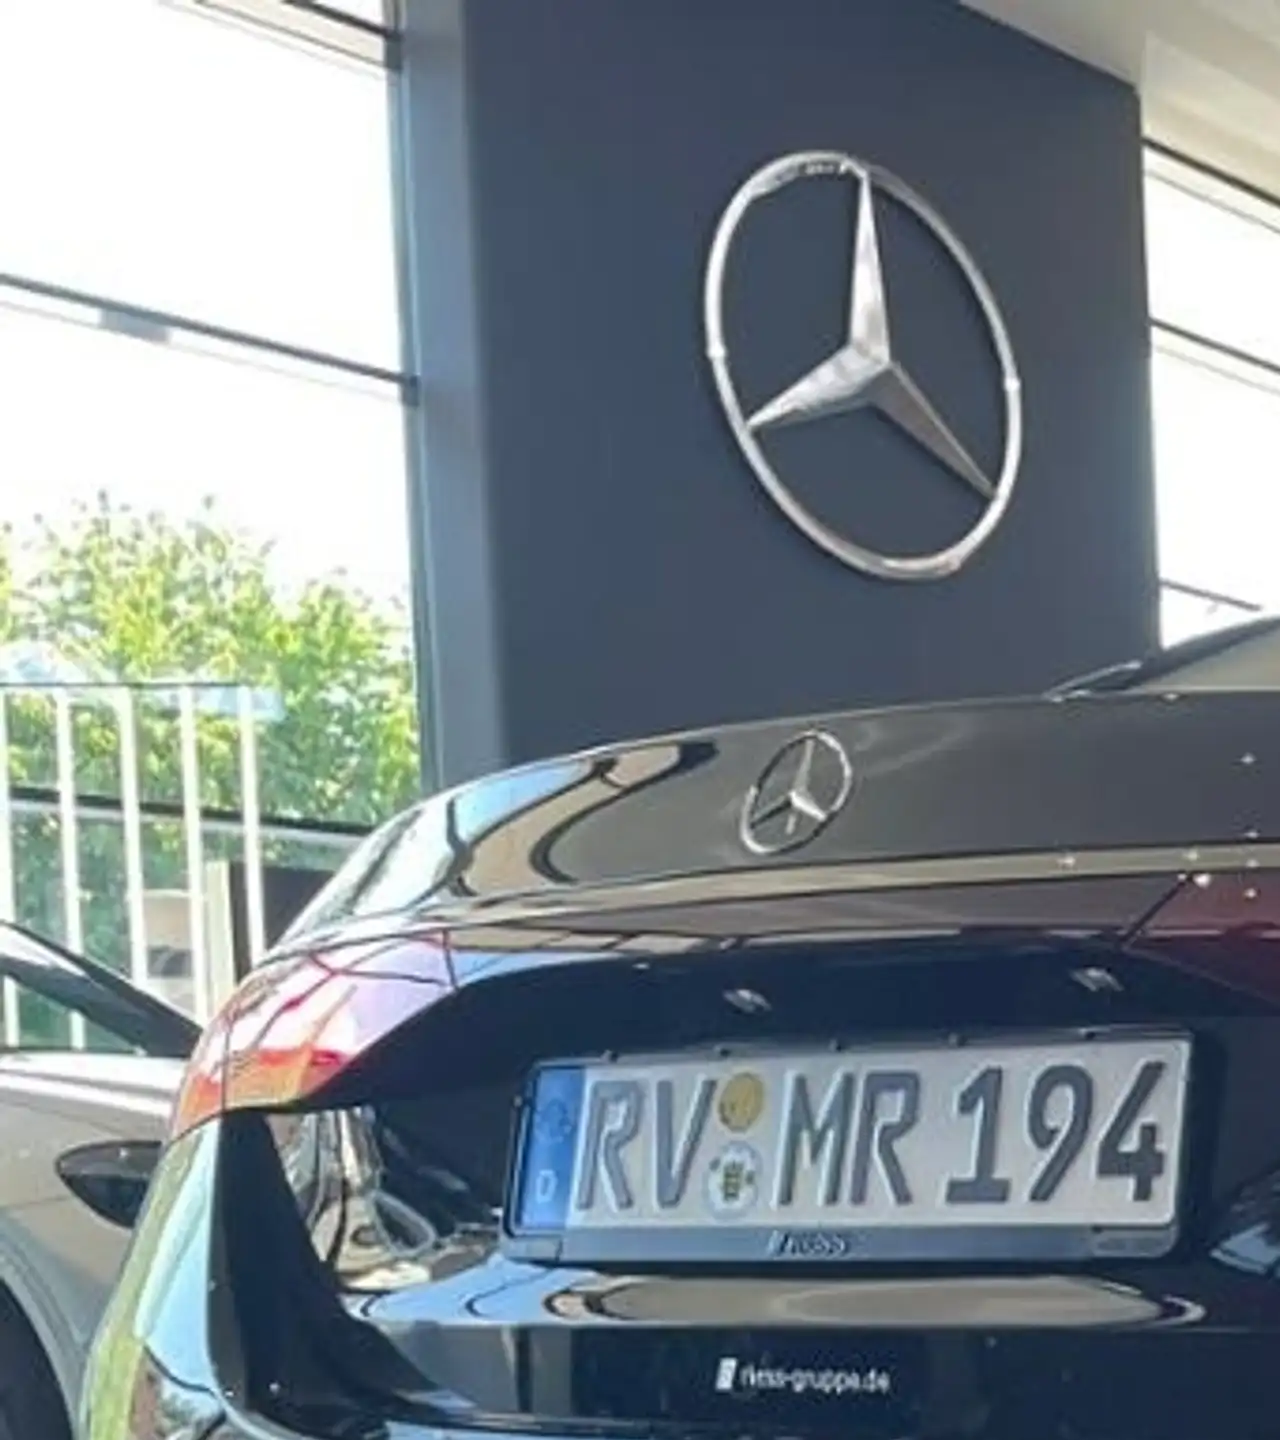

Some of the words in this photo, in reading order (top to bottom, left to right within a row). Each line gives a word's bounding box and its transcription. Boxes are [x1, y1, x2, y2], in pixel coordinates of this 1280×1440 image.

[577, 1078, 717, 1212] RV
[770, 1069, 920, 1207] MR
[945, 1061, 1167, 1204] 194
